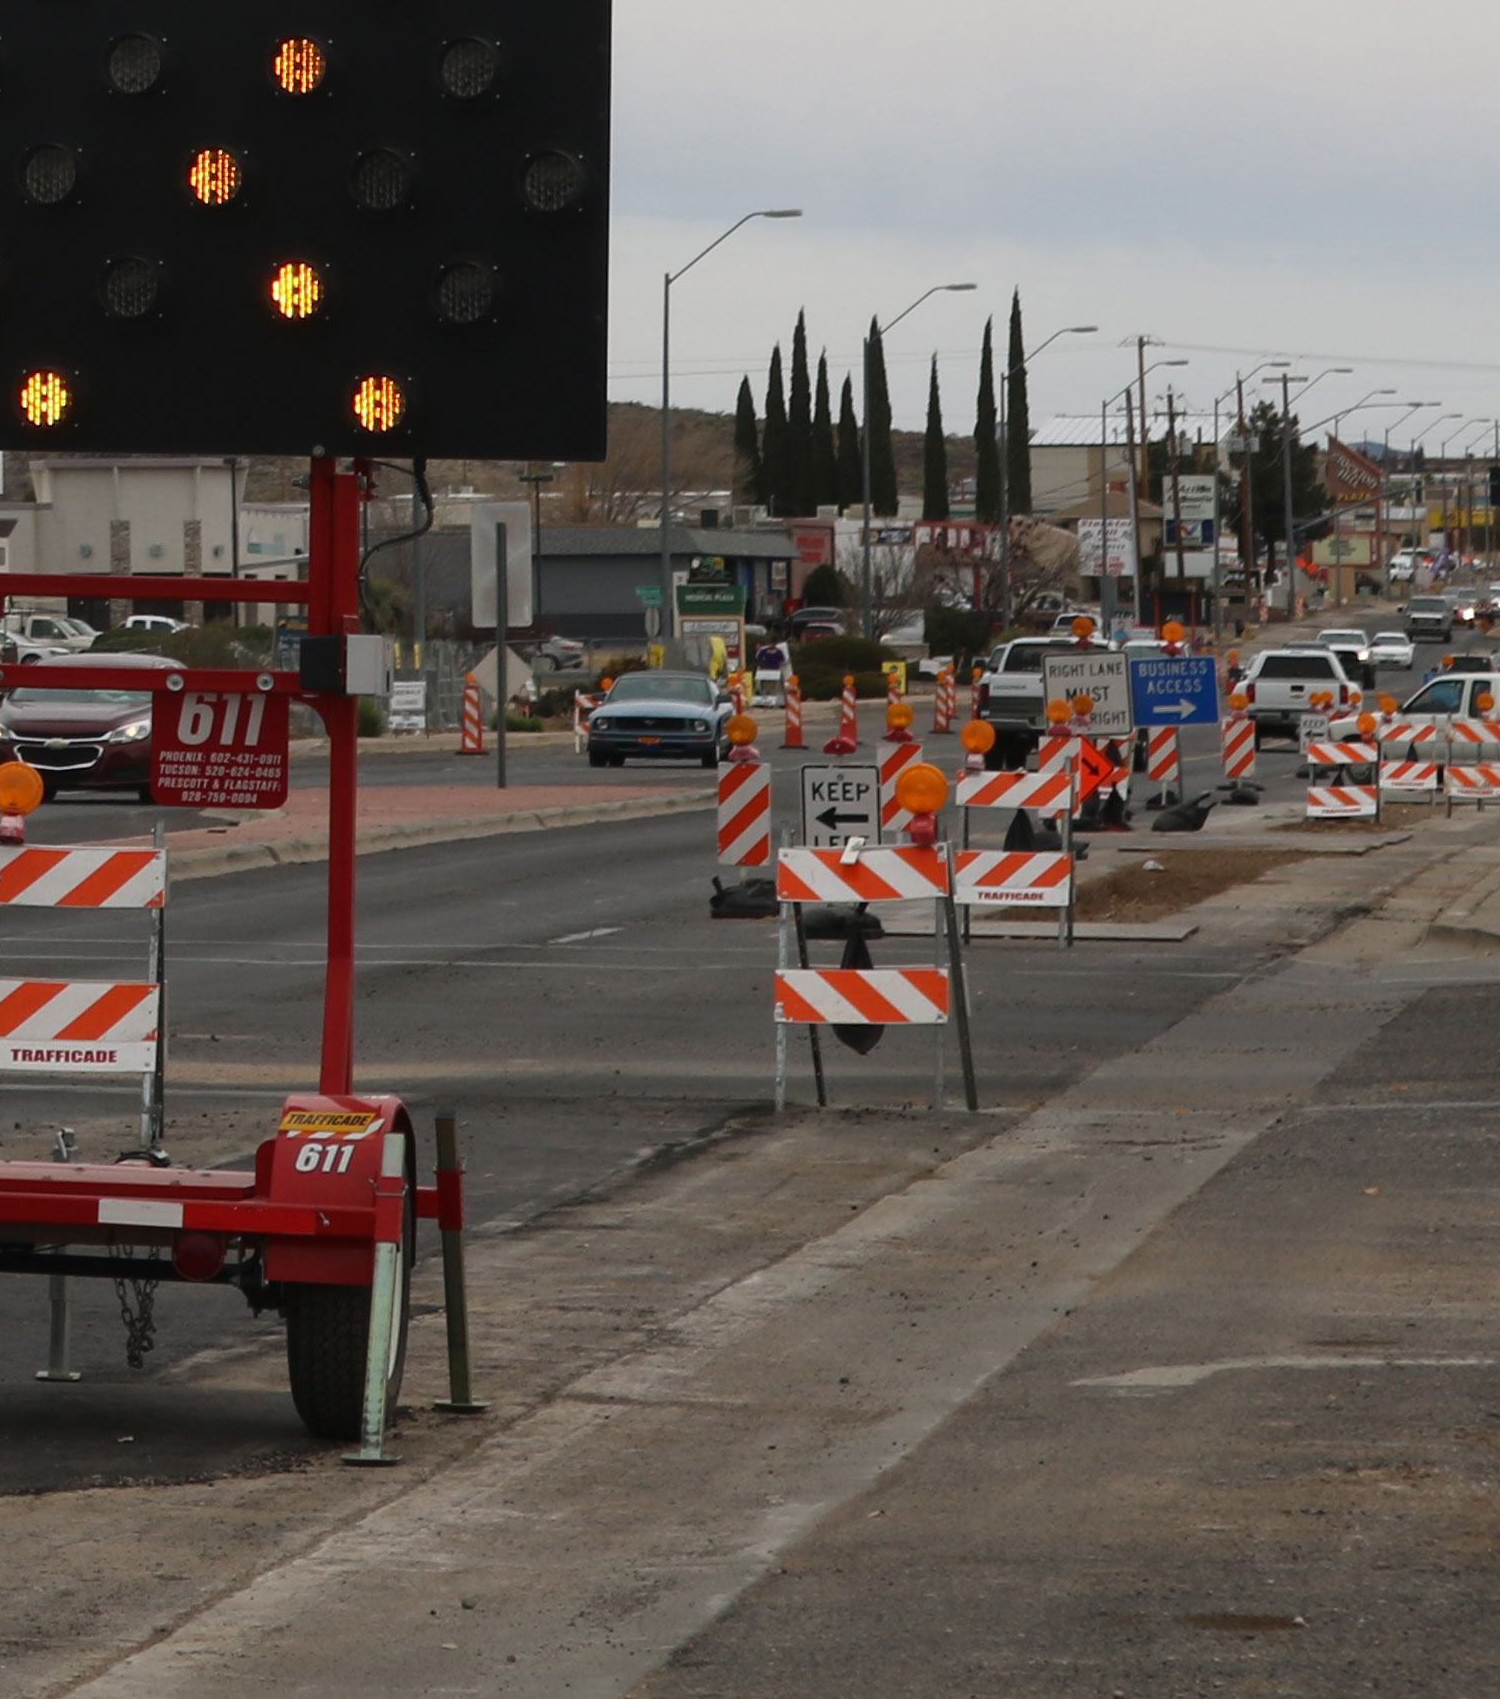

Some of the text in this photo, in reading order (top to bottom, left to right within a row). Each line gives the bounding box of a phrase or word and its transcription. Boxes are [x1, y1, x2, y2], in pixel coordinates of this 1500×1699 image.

[1049, 661, 1123, 678] RIGHT LANE
[1138, 659, 1208, 677] BUSINESS
[1146, 678, 1202, 694] ACCESS
[177, 693, 267, 746] 611
[1090, 711, 1126, 725] RIGHT
[159, 751, 282, 765] PHOENIX: 602-431-0911
[160, 764, 201, 775] TUCSON:
[158, 777, 282, 791] PRESCOTT & FLAGSTAFF:
[181, 791, 259, 804] 928-759-0094
[812, 782, 870, 802] KEEP
[977, 891, 1045, 901] TRAFFICADE
[10, 1048, 118, 1063] TRAFFICADE
[286, 1113, 372, 1126] TRAFFICADE
[295, 1143, 355, 1172] 611
